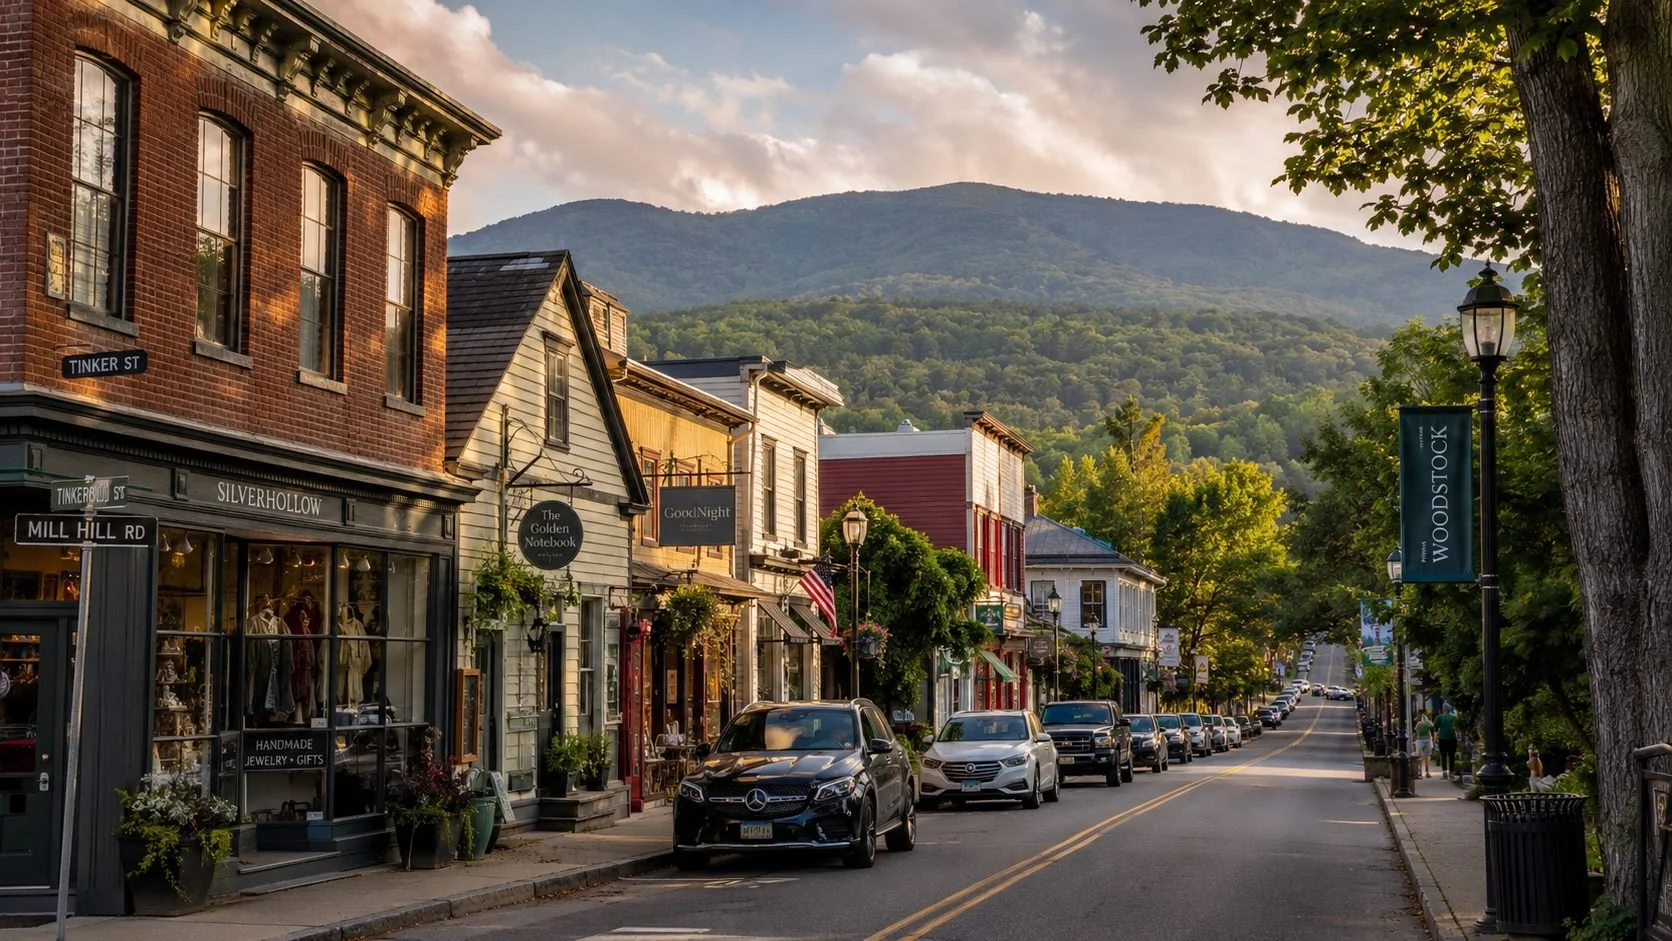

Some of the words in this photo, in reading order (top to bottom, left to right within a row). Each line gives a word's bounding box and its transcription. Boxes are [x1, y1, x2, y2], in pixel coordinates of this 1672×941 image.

[68, 357, 119, 375] TINKER
[124, 356, 140, 370] ST
[217, 481, 322, 515] SILVERHOLLOW
[1430, 425, 1449, 563] WOODSTOCK
[541, 509, 561, 521] The
[664, 506, 731, 521] GoodNight
[28, 520, 70, 539] MILL
[77, 521, 117, 540] HILL
[125, 524, 146, 540] RD
[530, 522, 569, 535] Golden
[525, 536, 576, 548] Notebook
[255, 739, 313, 751] HANDMADE
[244, 755, 288, 767] JEWELRY
[296, 754, 324, 766] GIFTS
